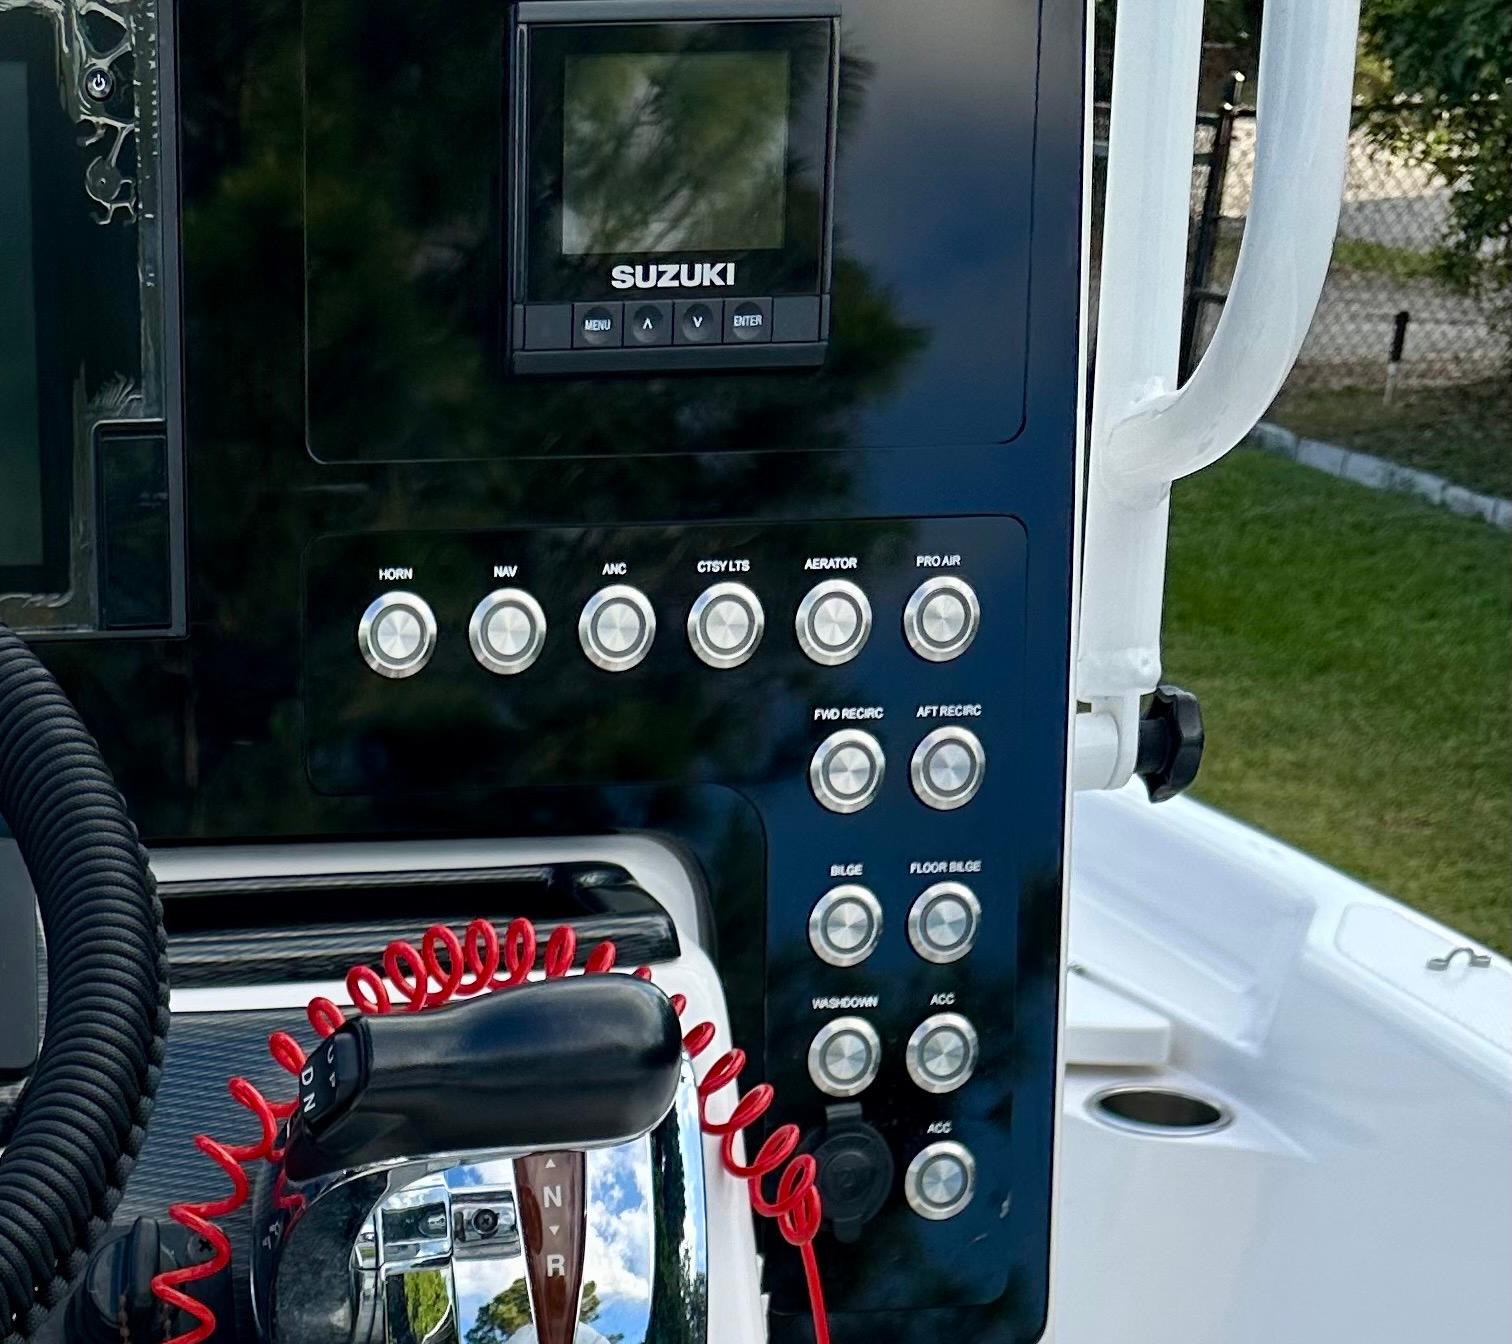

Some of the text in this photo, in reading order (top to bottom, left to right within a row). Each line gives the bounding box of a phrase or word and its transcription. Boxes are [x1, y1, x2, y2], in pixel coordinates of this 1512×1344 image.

[611, 262, 736, 289] SUZUKI
[584, 318, 611, 331] MENU
[733, 314, 763, 327] ENTER
[696, 559, 751, 573] CTSY LTS
[804, 556, 858, 570] AERATOR
[916, 554, 961, 567] PRO AIR
[378, 567, 414, 581] HORN
[493, 565, 518, 579] NAV
[602, 563, 627, 576] ANC
[814, 706, 884, 721] FWD RECIRC
[916, 704, 982, 718] AFT RECIRC
[830, 864, 863, 877] BILGE
[909, 860, 981, 874] FLOOR BILGE
[812, 995, 879, 1009] WASHDOWN
[930, 993, 955, 1006] ACC
[927, 1121, 952, 1134] ACC
[543, 1185, 563, 1208] N
[546, 1253, 566, 1278] R
